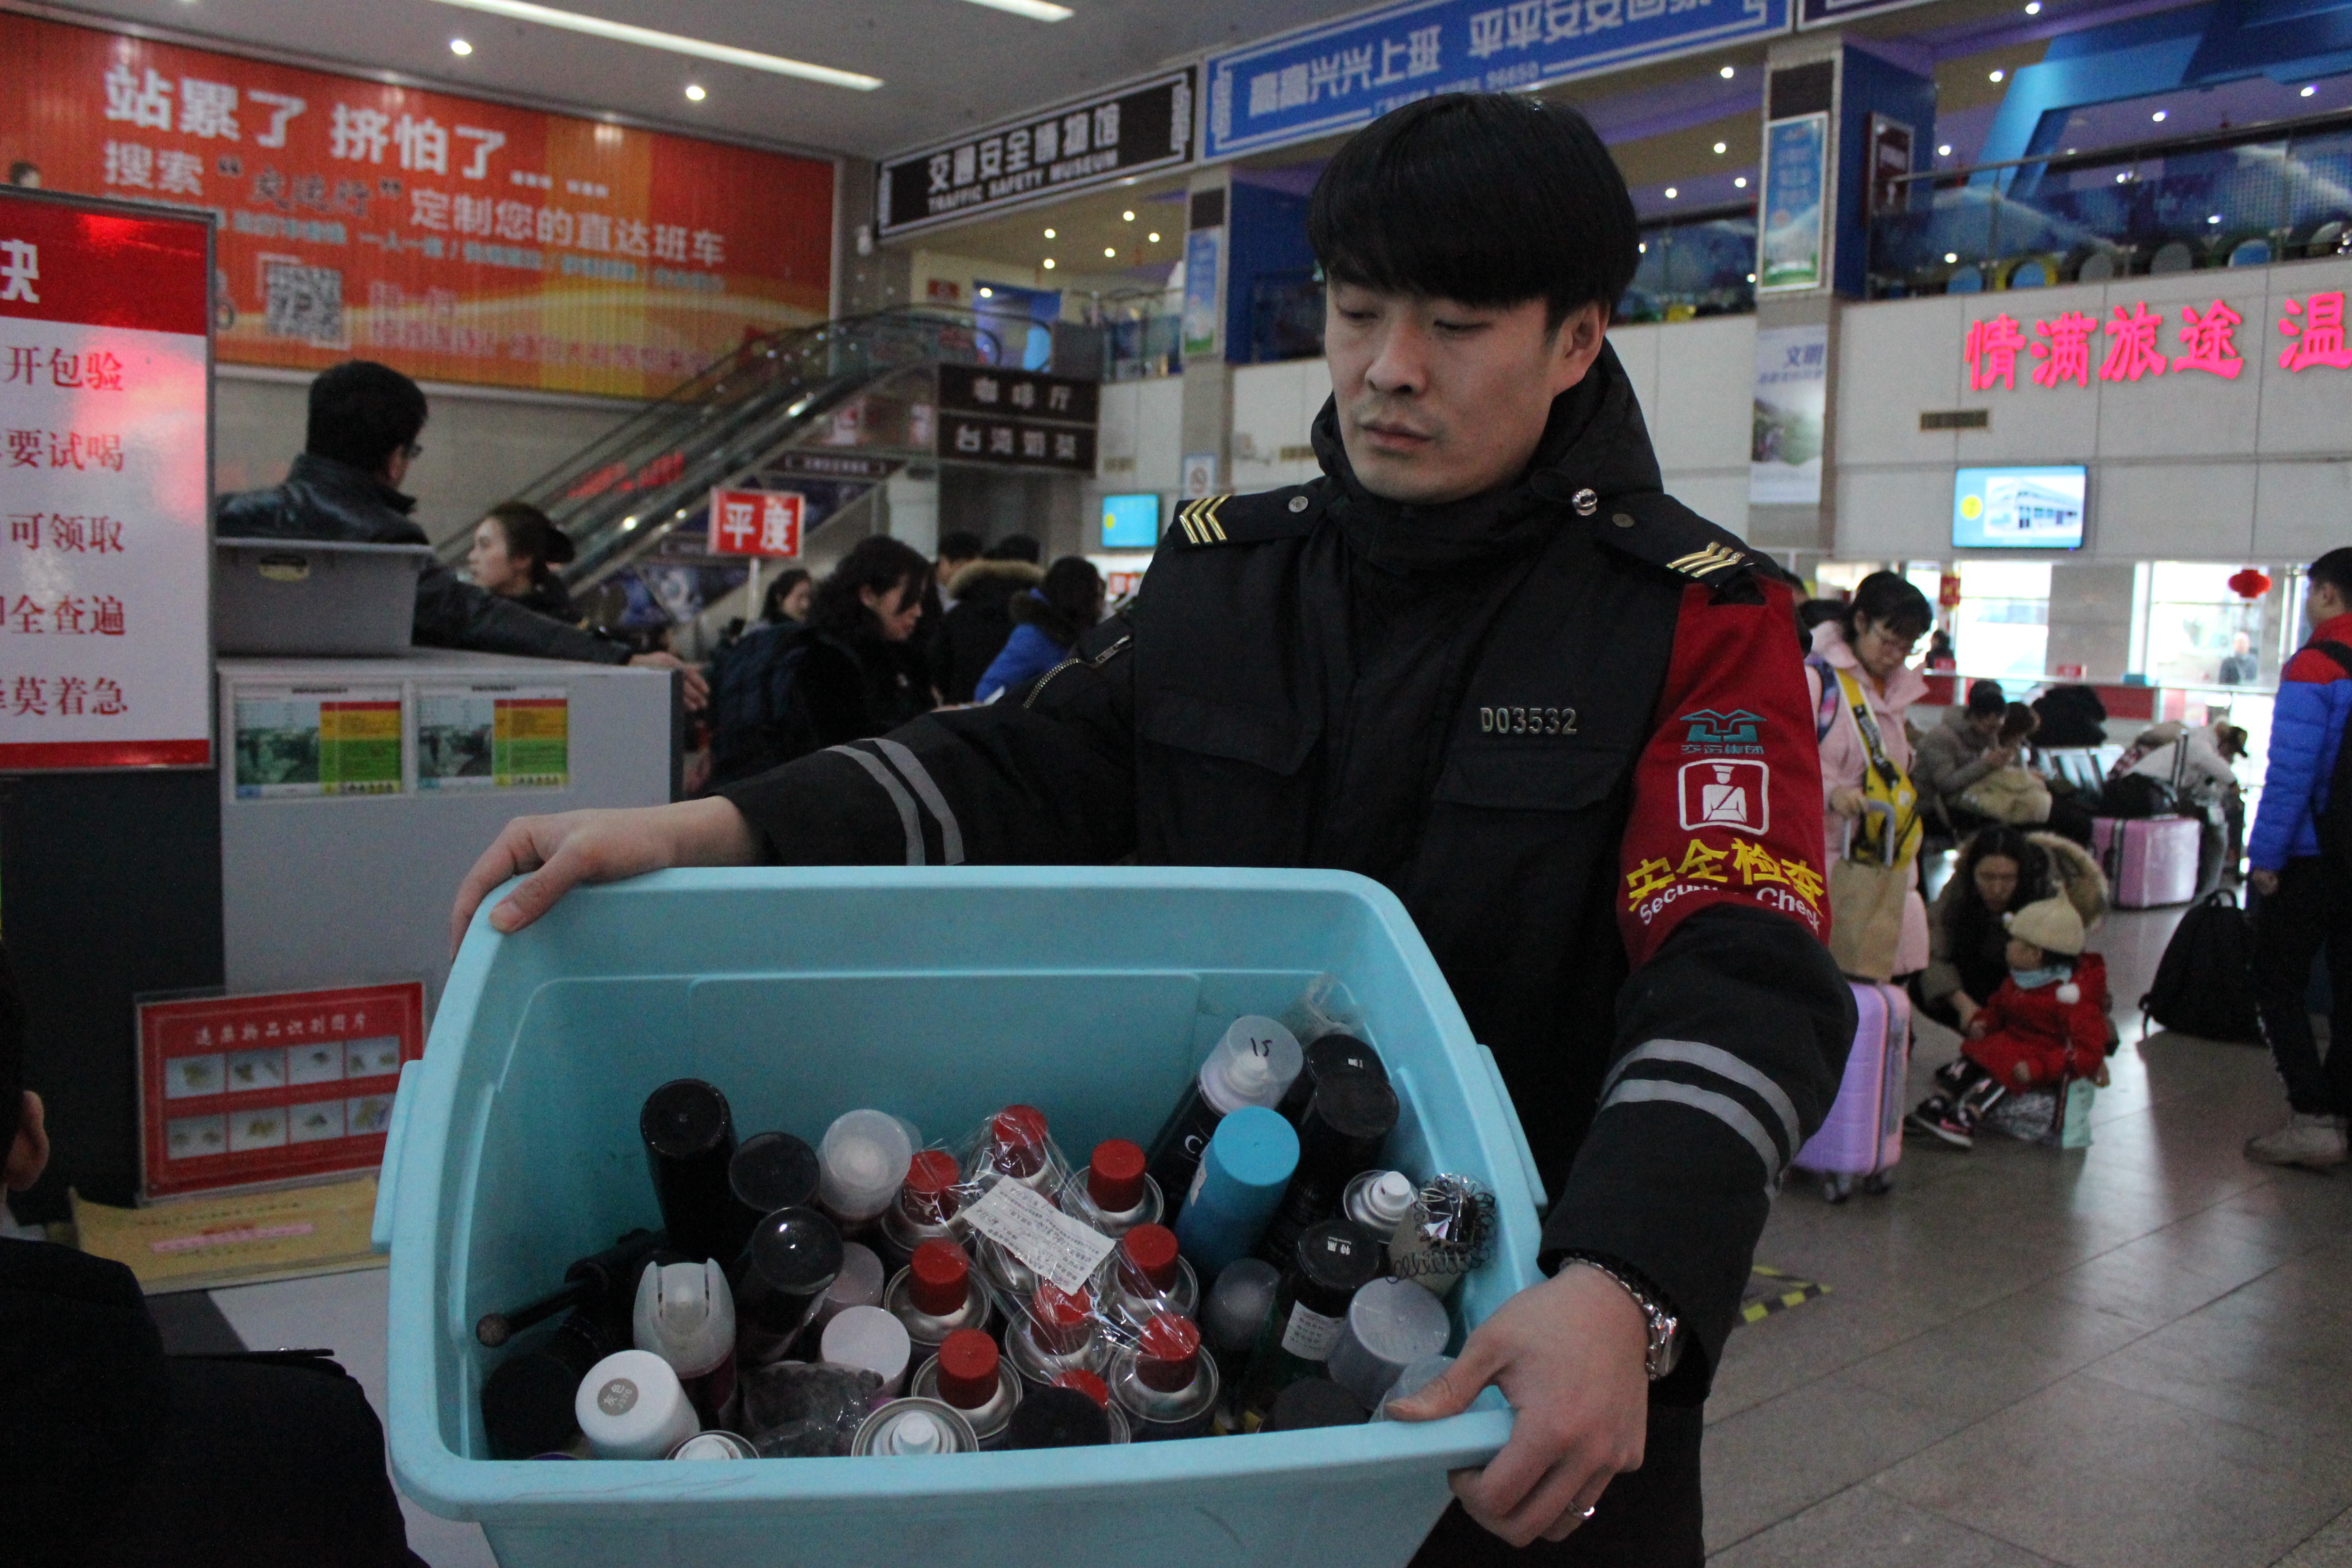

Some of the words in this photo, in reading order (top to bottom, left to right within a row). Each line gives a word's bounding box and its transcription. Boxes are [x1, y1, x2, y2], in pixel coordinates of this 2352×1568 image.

[1469, 0, 1712, 59] 平平安安
[104, 66, 306, 147] 站累了
[928, 102, 1120, 194] 交通安全博物馆
[104, 139, 203, 197] 搜索
[410, 189, 725, 266] 定制您的直达班车
[987, 168, 1044, 198] SAFETY
[1963, 299, 2244, 391] 情满旅途
[2277, 291, 2352, 373] 温
[5, 346, 125, 391] 开包验
[5, 429, 125, 472] 要试喝
[7, 512, 125, 554] 可领取
[723, 502, 794, 553] 平度
[0, 593, 126, 636] 全查遍
[0, 676, 128, 717] 莫着急
[1480, 706, 1578, 735] D03532
[1626, 837, 1825, 917] 安全检查
[1639, 884, 1740, 925] Secu
[1756, 887, 1822, 936] Check
[604, 1384, 625, 1407] 灰色
[617, 1389, 632, 1409] J370
